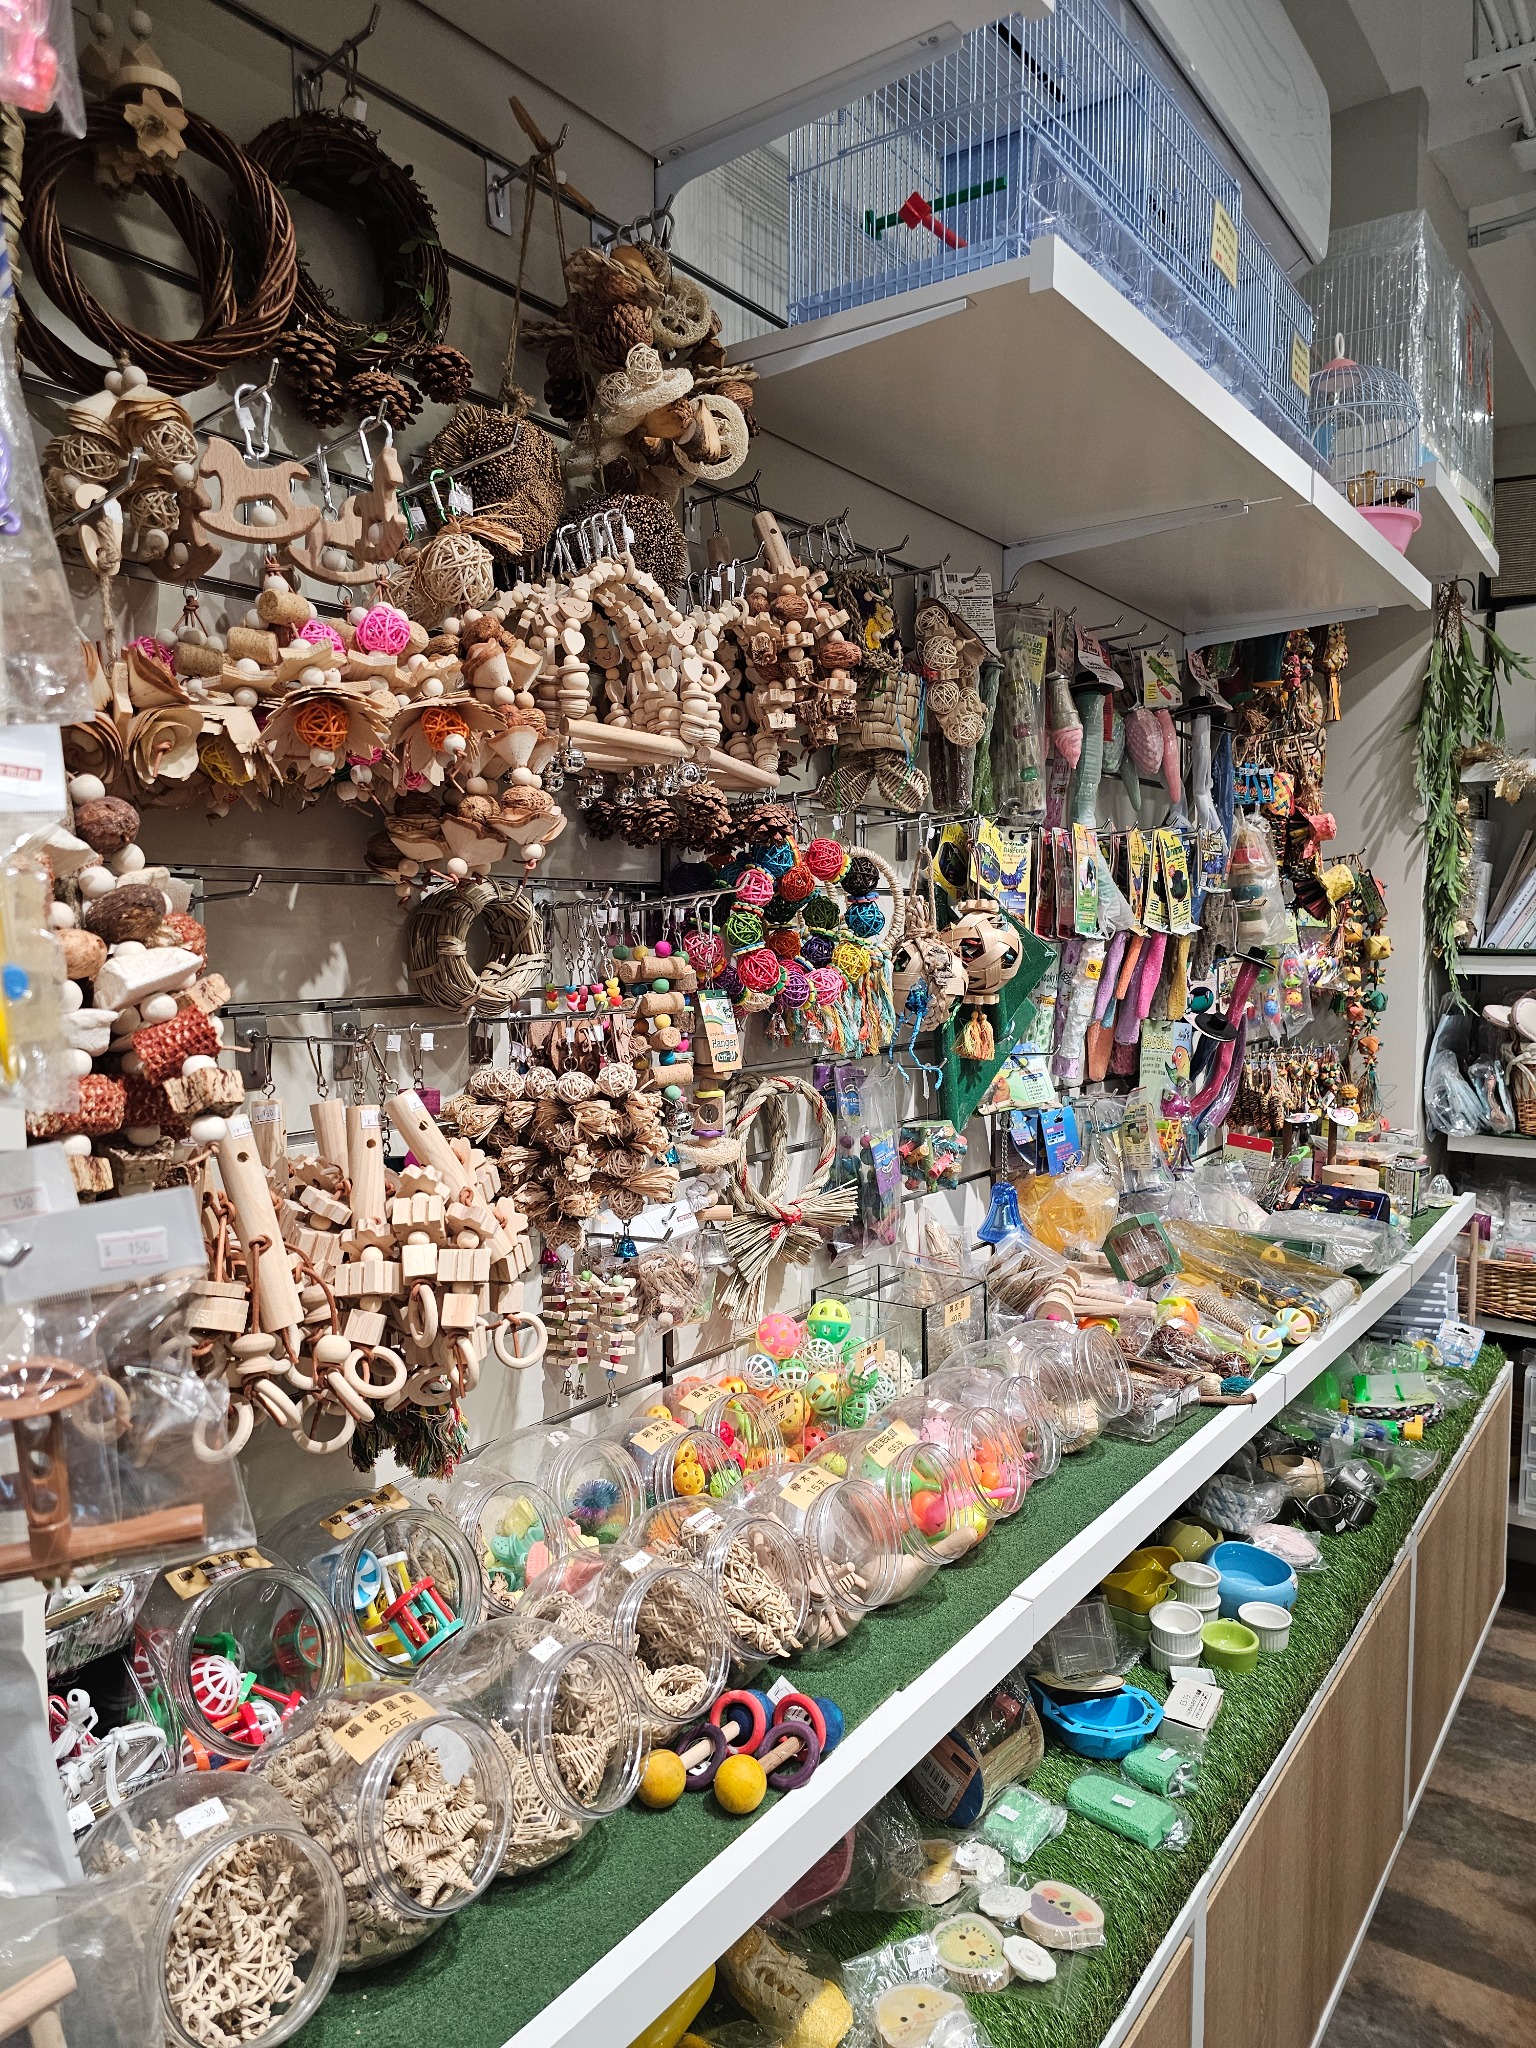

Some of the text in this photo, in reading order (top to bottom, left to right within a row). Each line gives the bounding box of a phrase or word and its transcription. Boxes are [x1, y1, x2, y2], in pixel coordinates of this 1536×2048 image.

[345, 1694, 416, 1739] 編織星星
[379, 1710, 418, 1735] 25元
